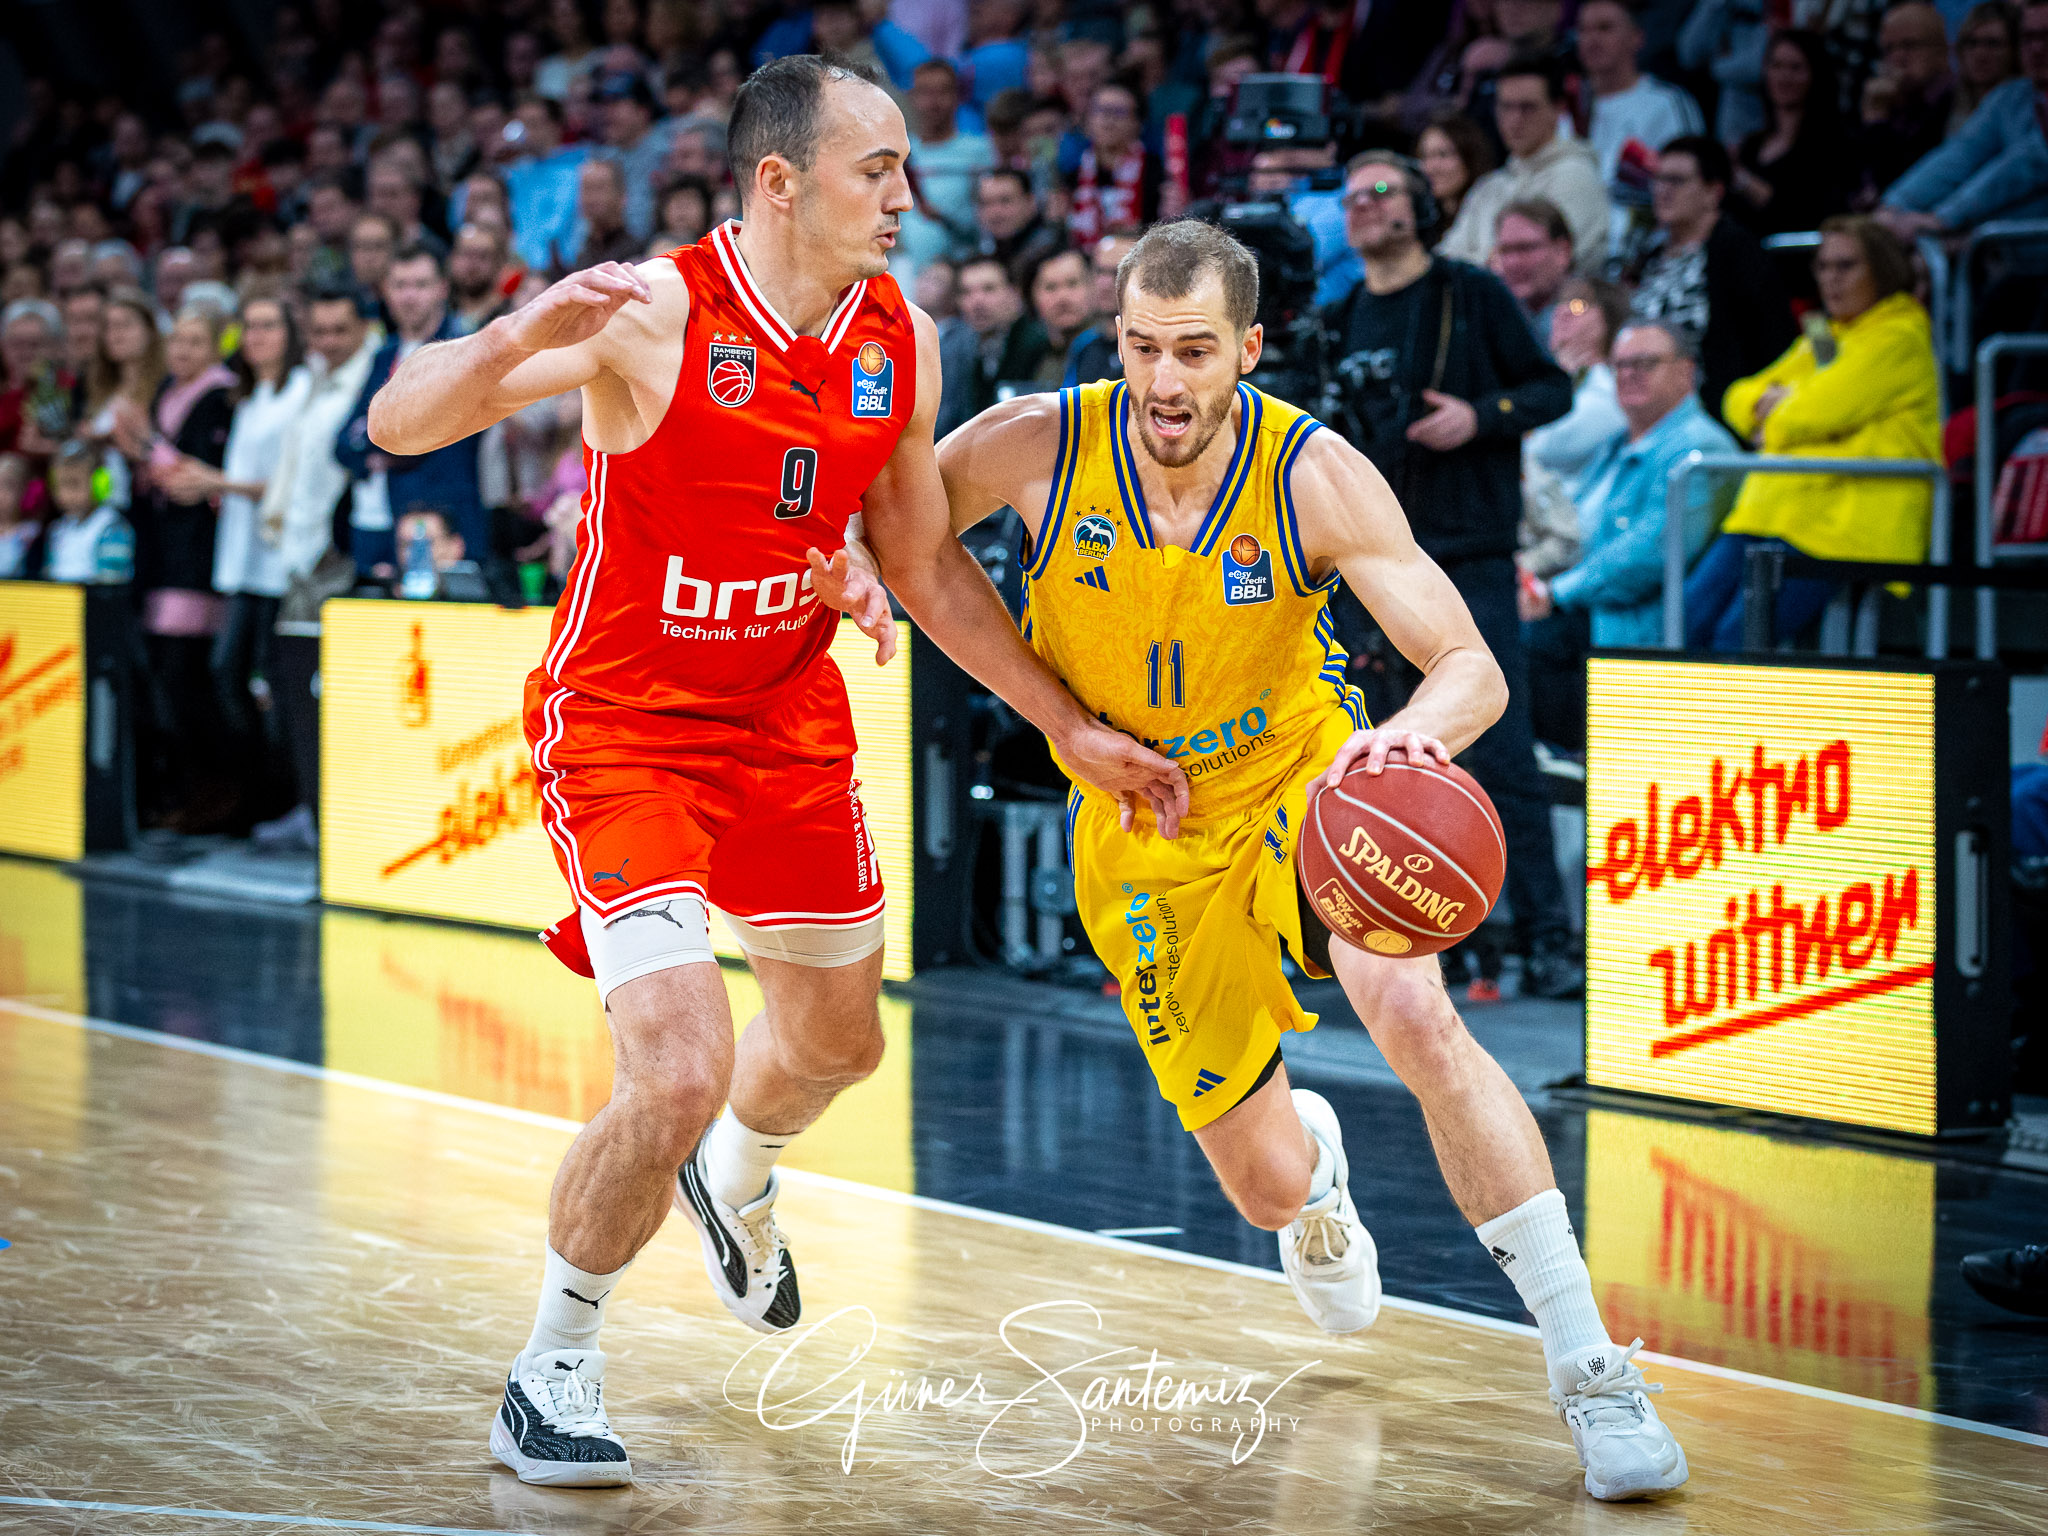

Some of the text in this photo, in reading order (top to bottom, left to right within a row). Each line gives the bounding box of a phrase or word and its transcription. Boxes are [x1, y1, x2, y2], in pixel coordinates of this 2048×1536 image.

[713, 347, 752, 356] BAMBERG
[713, 352, 752, 360] BASKETS
[866, 387, 888, 395] Credit
[856, 395, 887, 411] BBL
[774, 447, 818, 520] 9
[1077, 540, 1108, 555] ALBA
[1078, 549, 1105, 560] BERLIN
[661, 555, 818, 620] bros
[1240, 576, 1267, 585] Credit
[1230, 585, 1268, 600] BBL
[659, 619, 737, 641] Technik
[744, 623, 770, 639] für
[1145, 639, 1185, 708] 11
[1588, 740, 1851, 904] elektro
[855, 832, 868, 893] KOLLEGEN
[1338, 825, 1466, 931] SPALDING
[1320, 897, 1352, 934] BBL
[1650, 866, 1918, 1027] wittner
